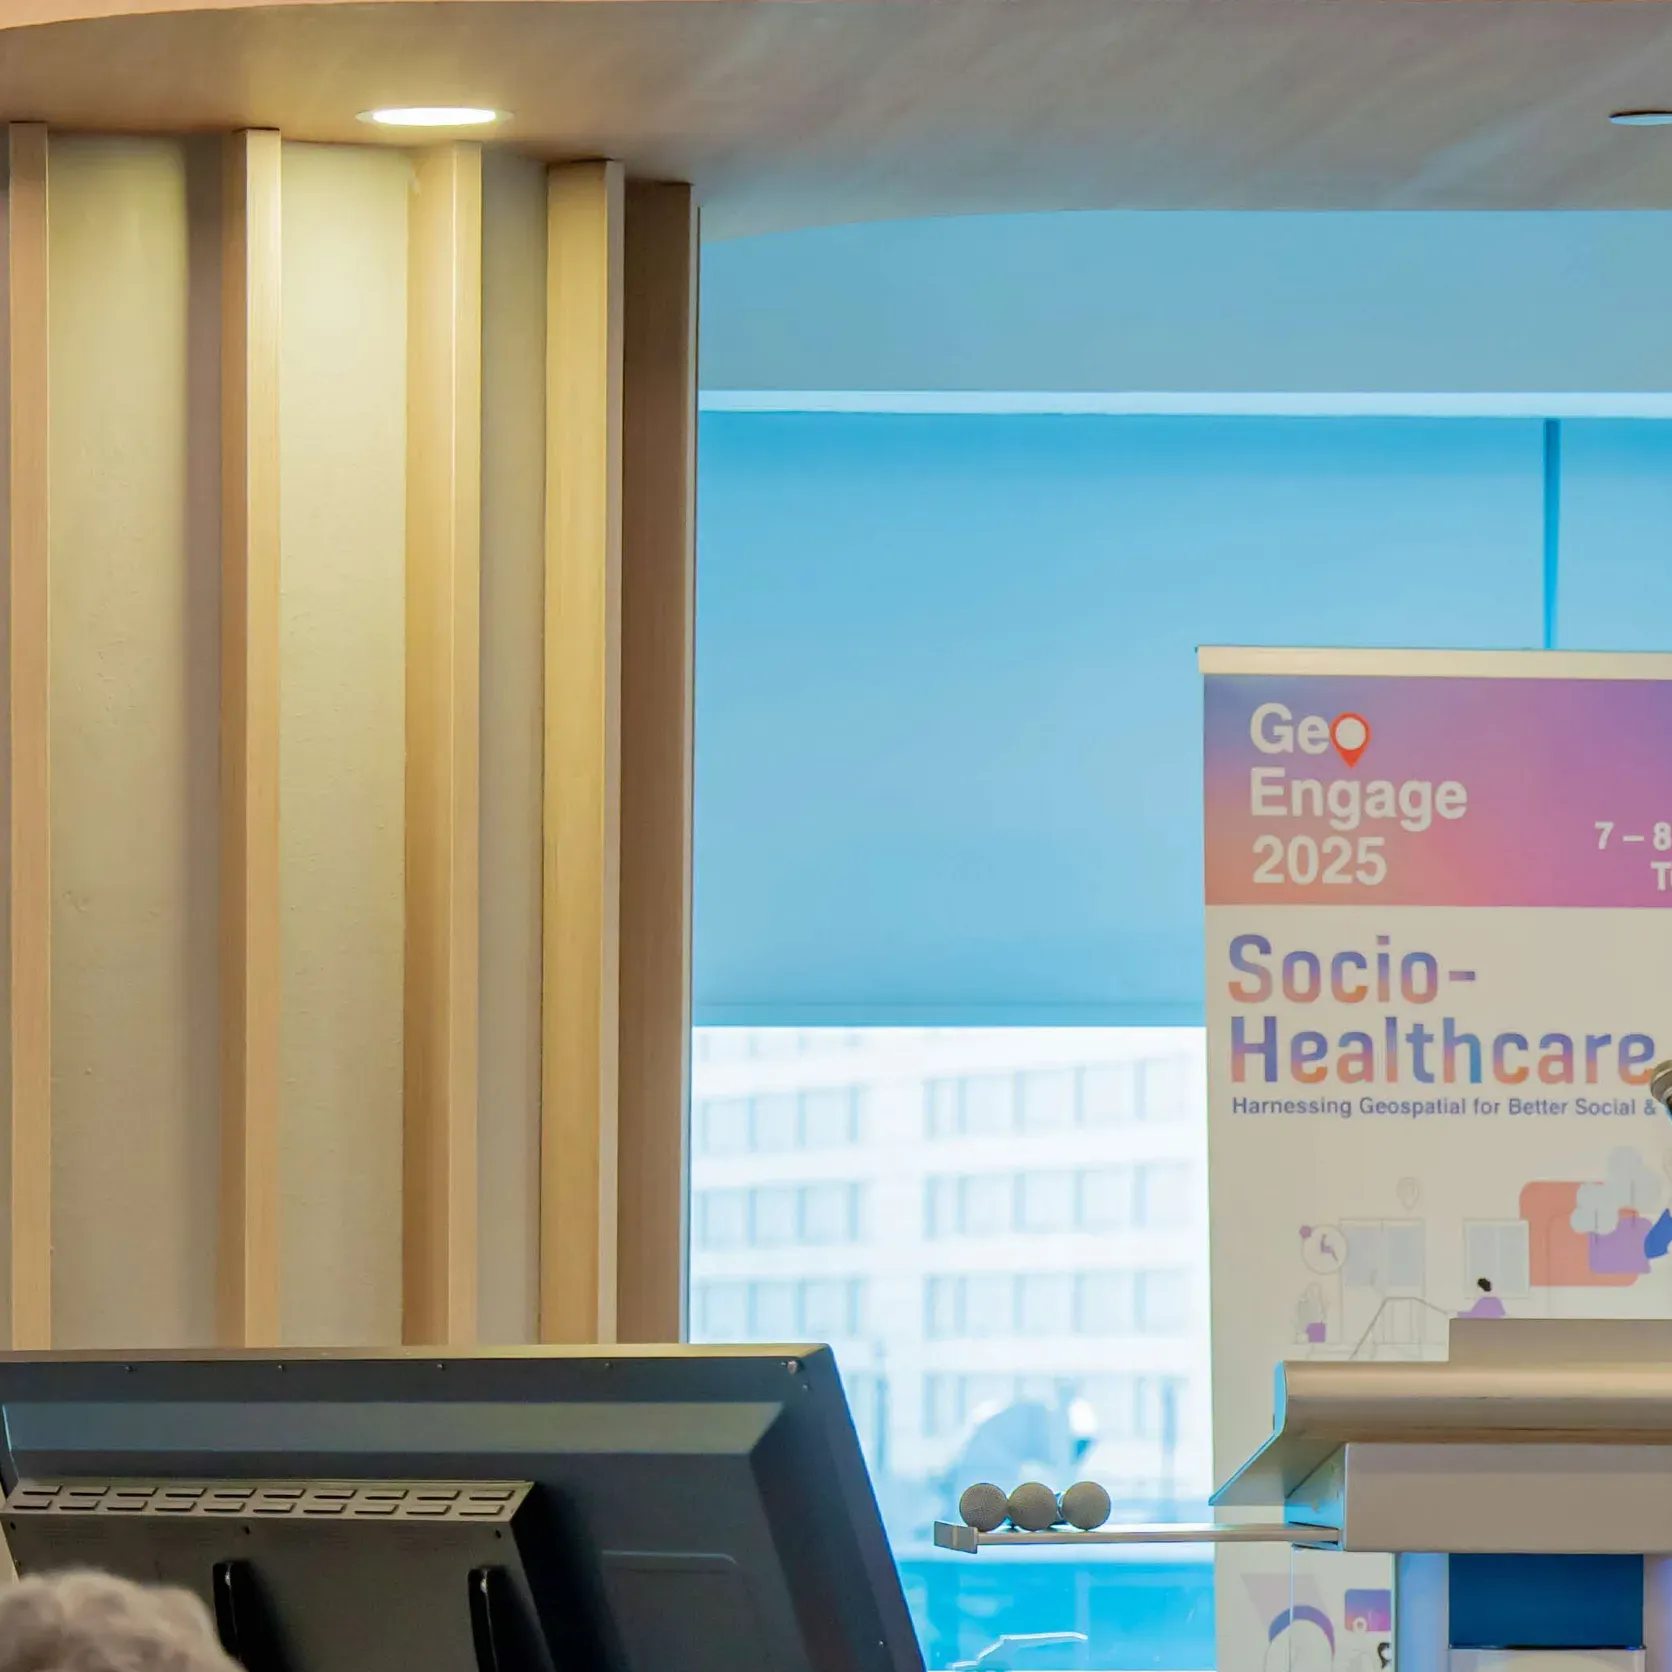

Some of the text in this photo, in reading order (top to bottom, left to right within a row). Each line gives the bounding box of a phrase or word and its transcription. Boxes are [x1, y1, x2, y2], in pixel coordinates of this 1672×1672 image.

[1250, 767, 1468, 833] Engage
[1252, 835, 1387, 887] 2025
[1594, 822, 1615, 851] 7
[1652, 822, 1672, 852] 8
[1227, 934, 1477, 1006] Socio-
[1230, 1016, 1657, 1089] Healthcare
[1232, 1097, 1657, 1121] Harnessing Geospatial for Better Social &
